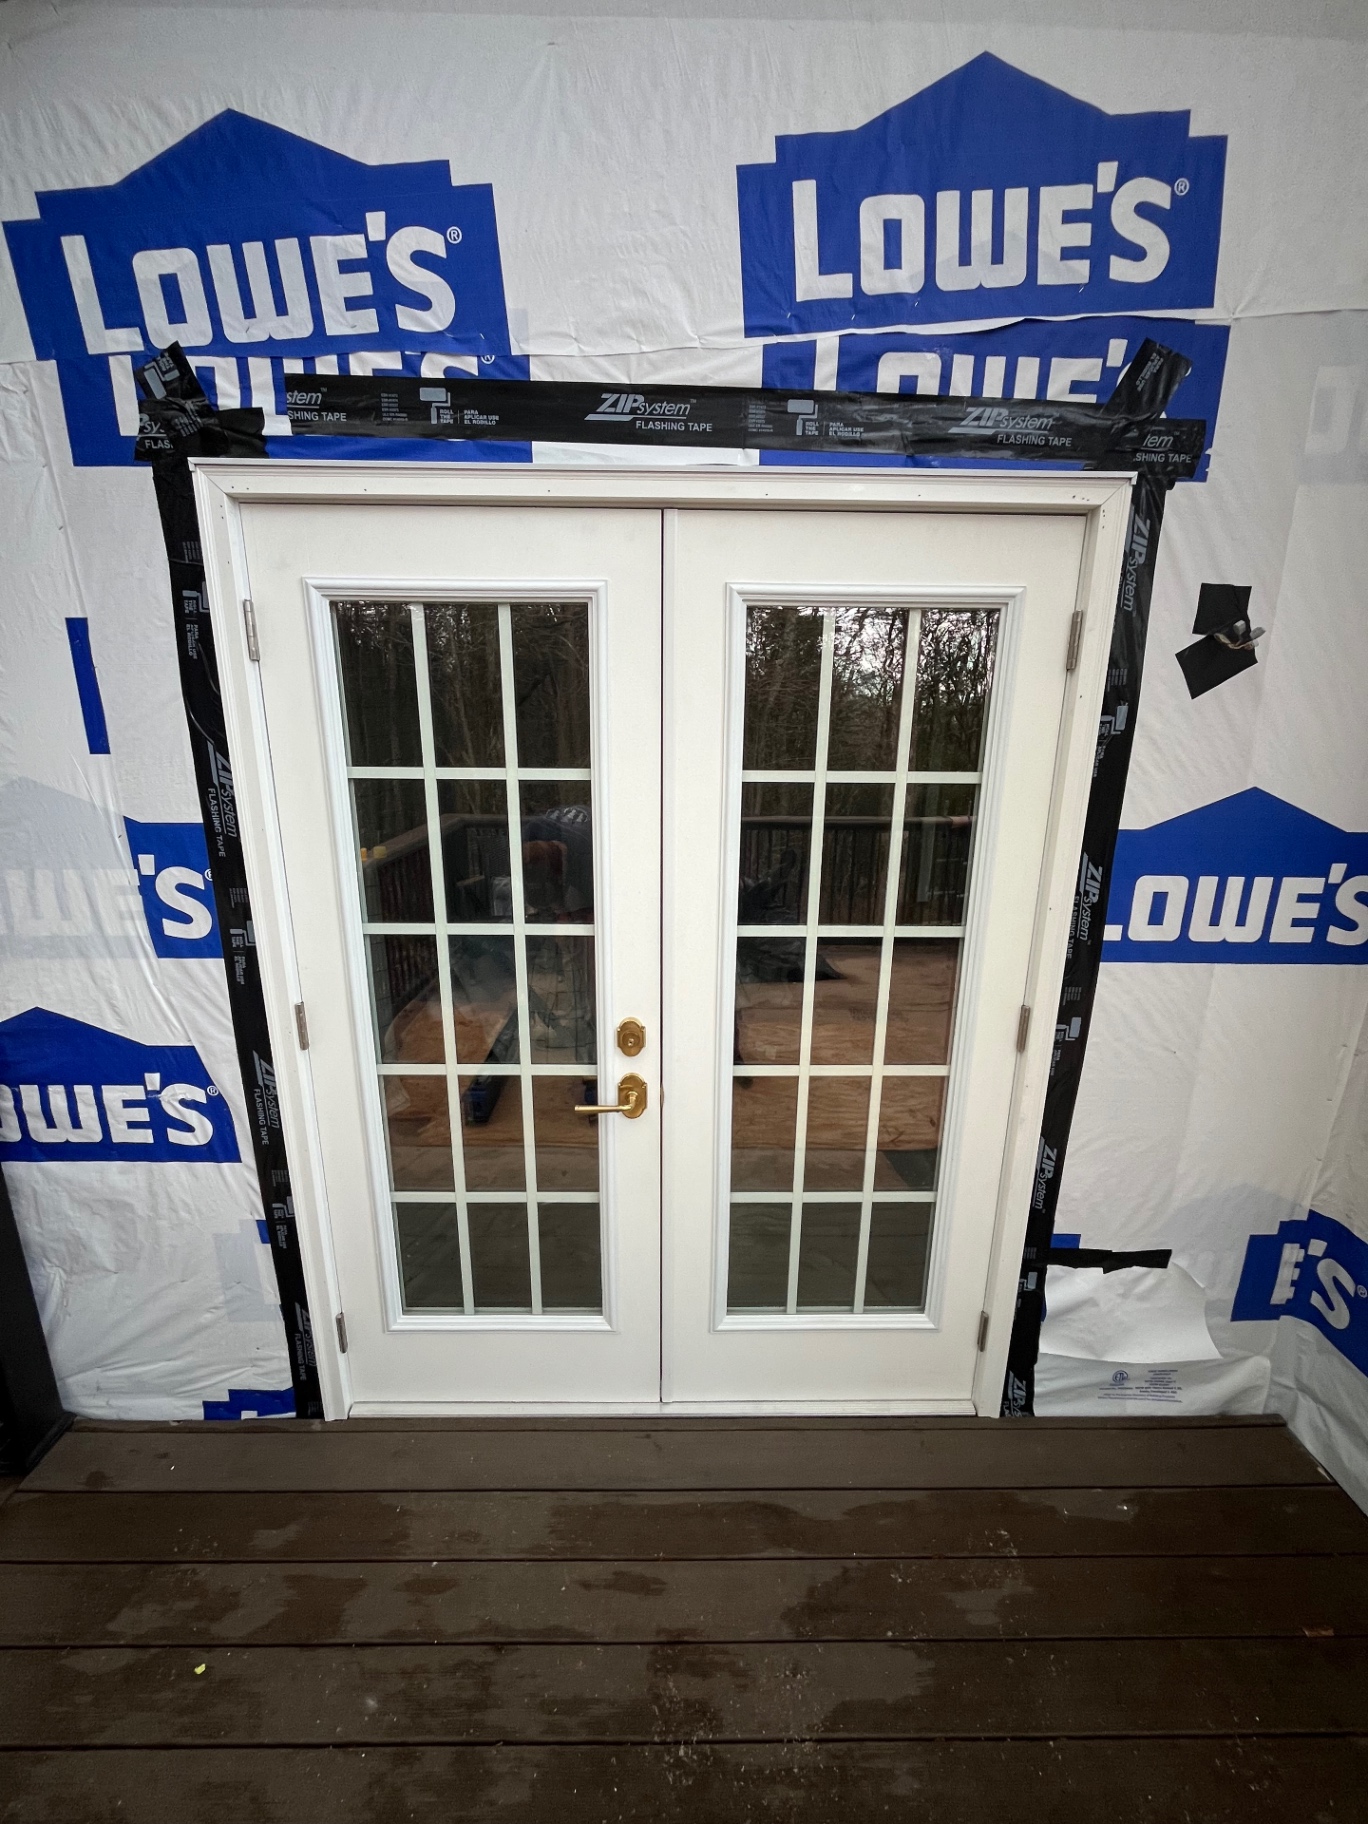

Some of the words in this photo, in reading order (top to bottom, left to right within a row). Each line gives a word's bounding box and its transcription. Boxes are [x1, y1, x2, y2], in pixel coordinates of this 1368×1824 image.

[792, 161, 1172, 302] LOWE'S
[61, 211, 456, 354] LOWE'S
[321, 411, 347, 422] TAPE
[635, 420, 685, 431] FLASHING
[687, 422, 713, 432] TAPE
[996, 434, 1046, 446] FLASHING
[1047, 436, 1073, 447] TAPE
[1167, 453, 1193, 464] TAPE
[207, 787, 222, 833] FLASHING
[215, 834, 227, 858] TAPE
[1104, 862, 1368, 946] OWE'S
[253, 1088, 266, 1126] FLASHING
[261, 1125, 270, 1146] TAPE
